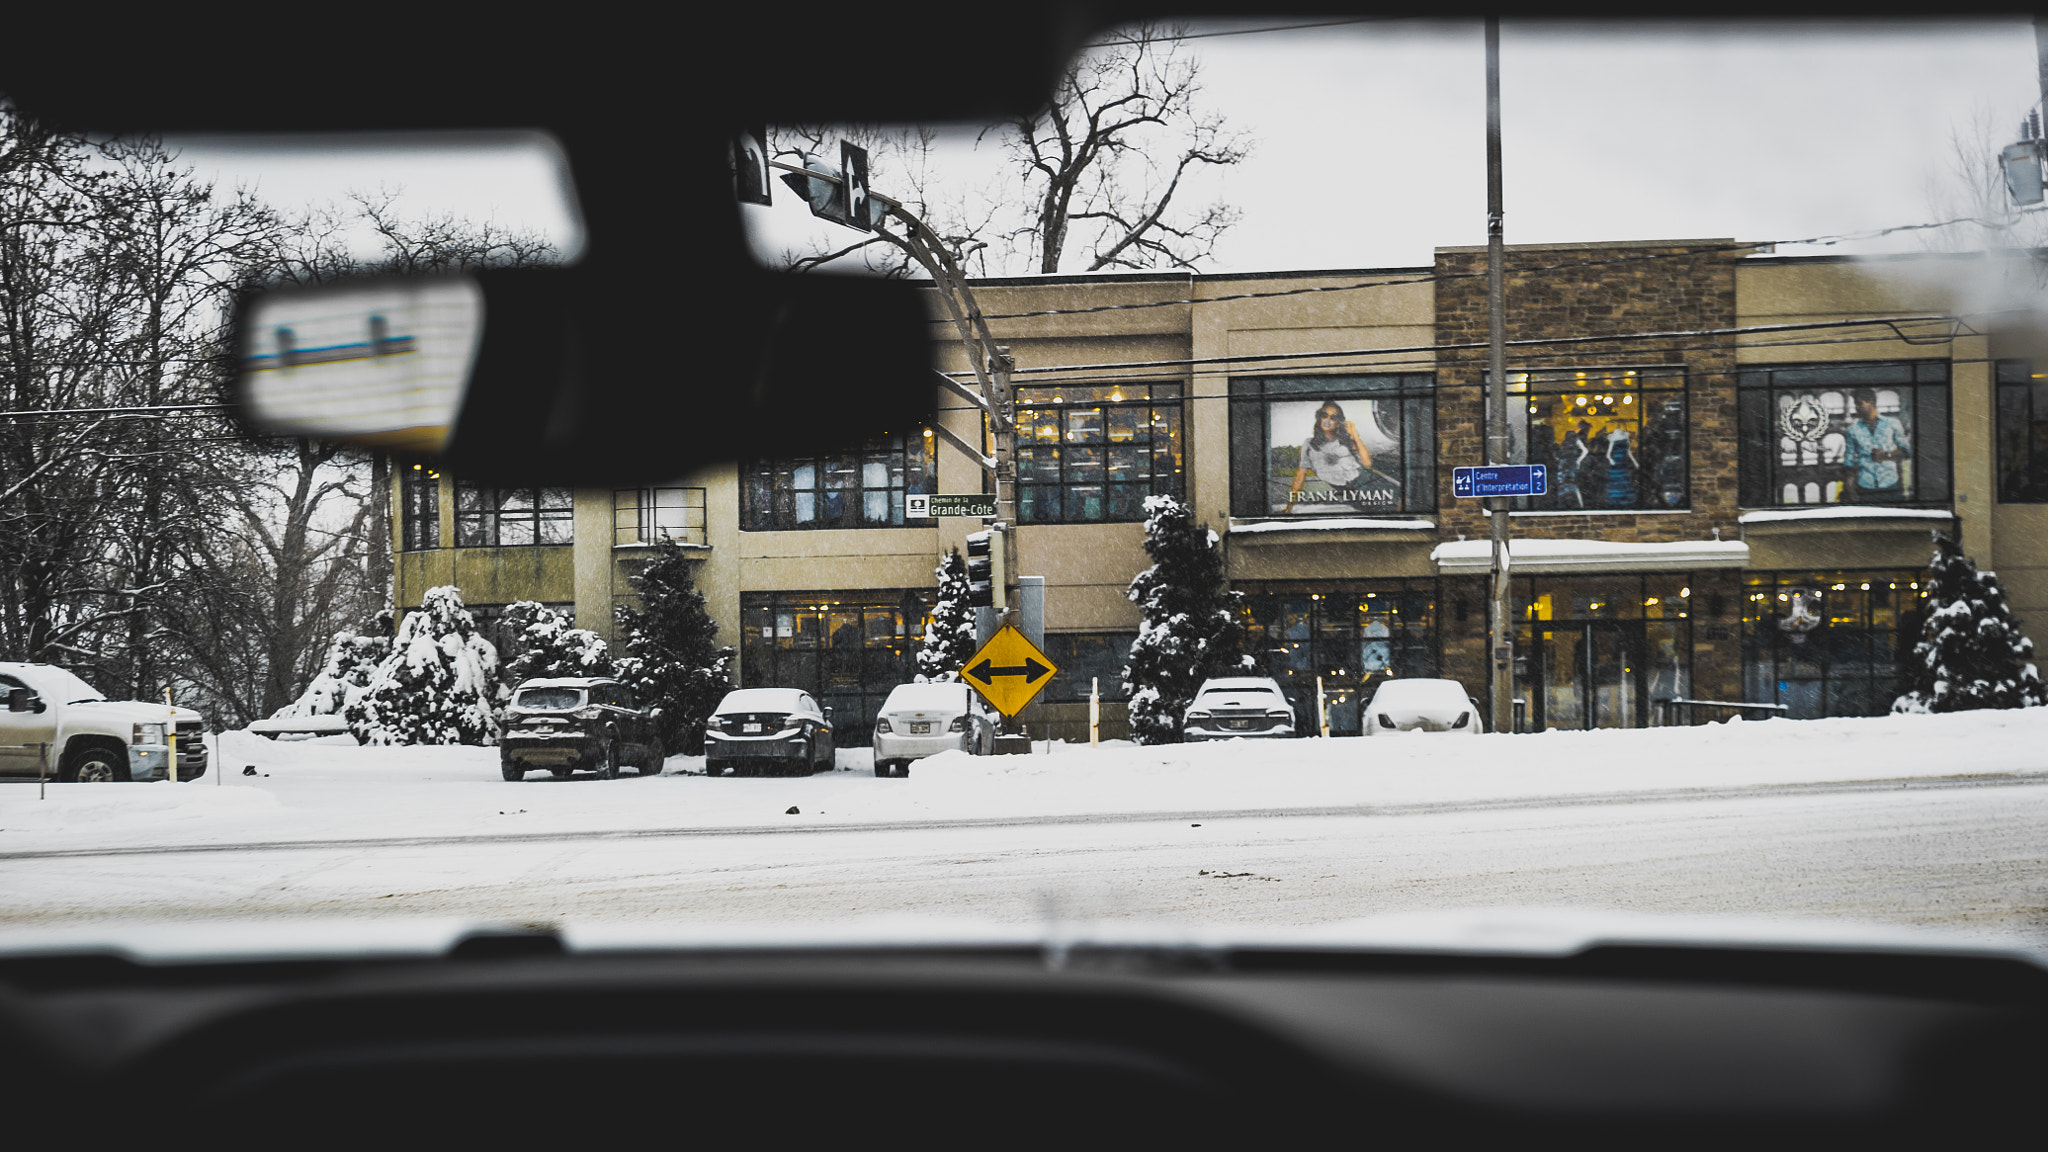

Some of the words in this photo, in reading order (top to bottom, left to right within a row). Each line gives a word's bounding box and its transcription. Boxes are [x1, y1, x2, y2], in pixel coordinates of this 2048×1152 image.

[1475, 471, 1498, 480] Centre
[1536, 481, 1542, 491] 2
[1289, 490, 1338, 502] FRANK
[1343, 489, 1394, 501] LYMAN
[931, 504, 993, 515] Grande-Côte
